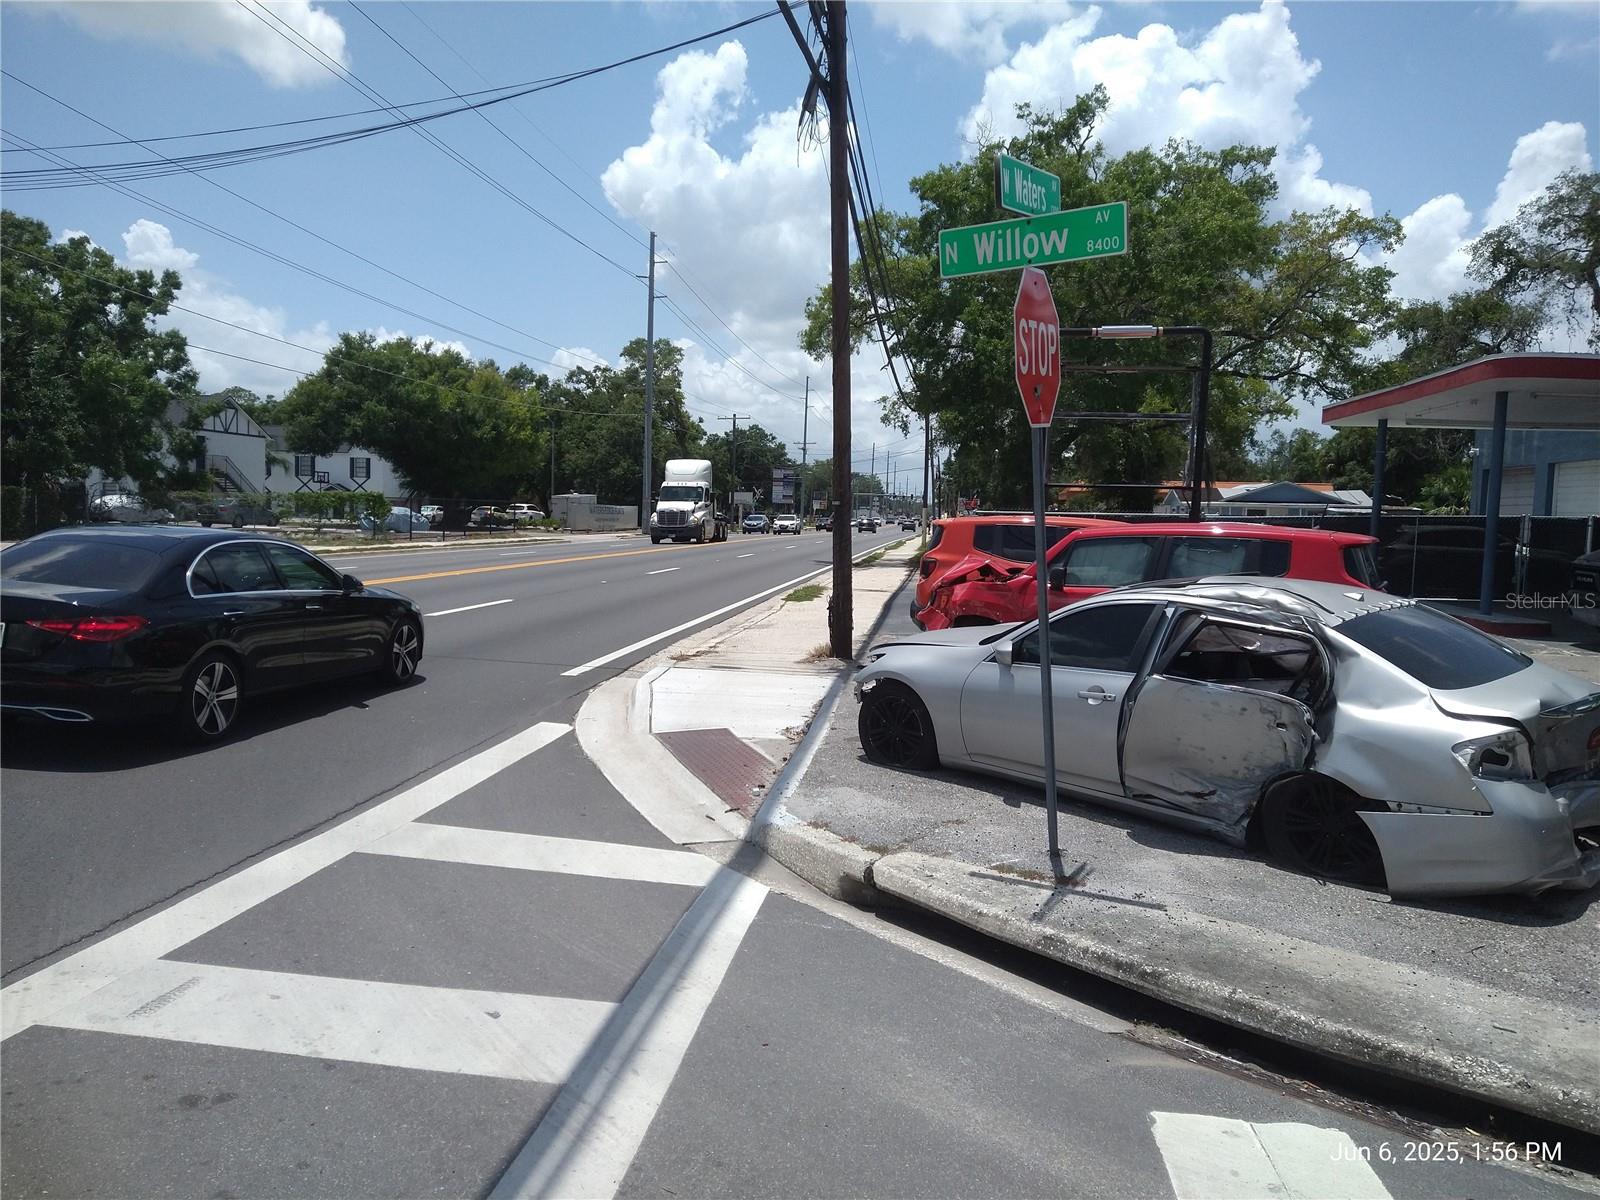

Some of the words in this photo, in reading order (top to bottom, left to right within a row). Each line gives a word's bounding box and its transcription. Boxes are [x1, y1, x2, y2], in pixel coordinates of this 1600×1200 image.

[1002, 167, 1010, 194] W
[1014, 167, 1047, 213] Waters
[1095, 209, 1111, 224] AV
[945, 241, 958, 265] N
[973, 227, 1069, 265] Willow
[1086, 236, 1120, 253] 8400
[1019, 317, 1057, 377] STOP
